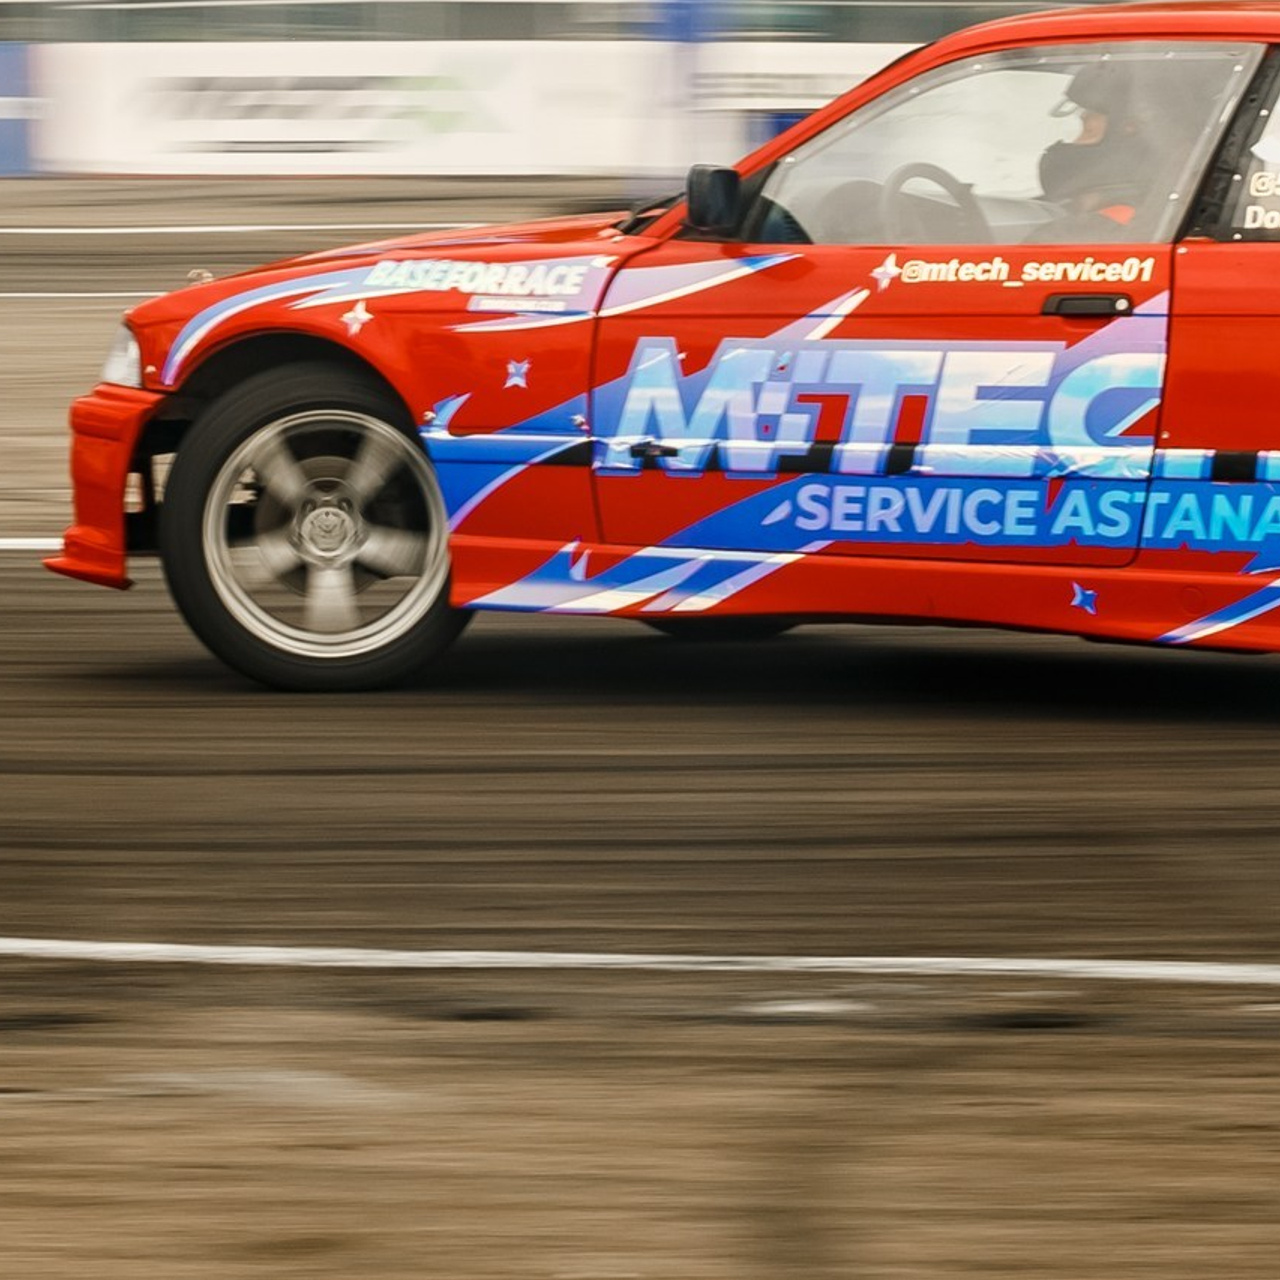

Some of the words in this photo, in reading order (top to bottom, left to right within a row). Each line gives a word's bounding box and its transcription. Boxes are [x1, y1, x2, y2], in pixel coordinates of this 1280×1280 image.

[362, 259, 590, 297] BASEFORRACE
[900, 256, 1155, 288] @mtech_service01
[795, 483, 1040, 537] SERVICE
